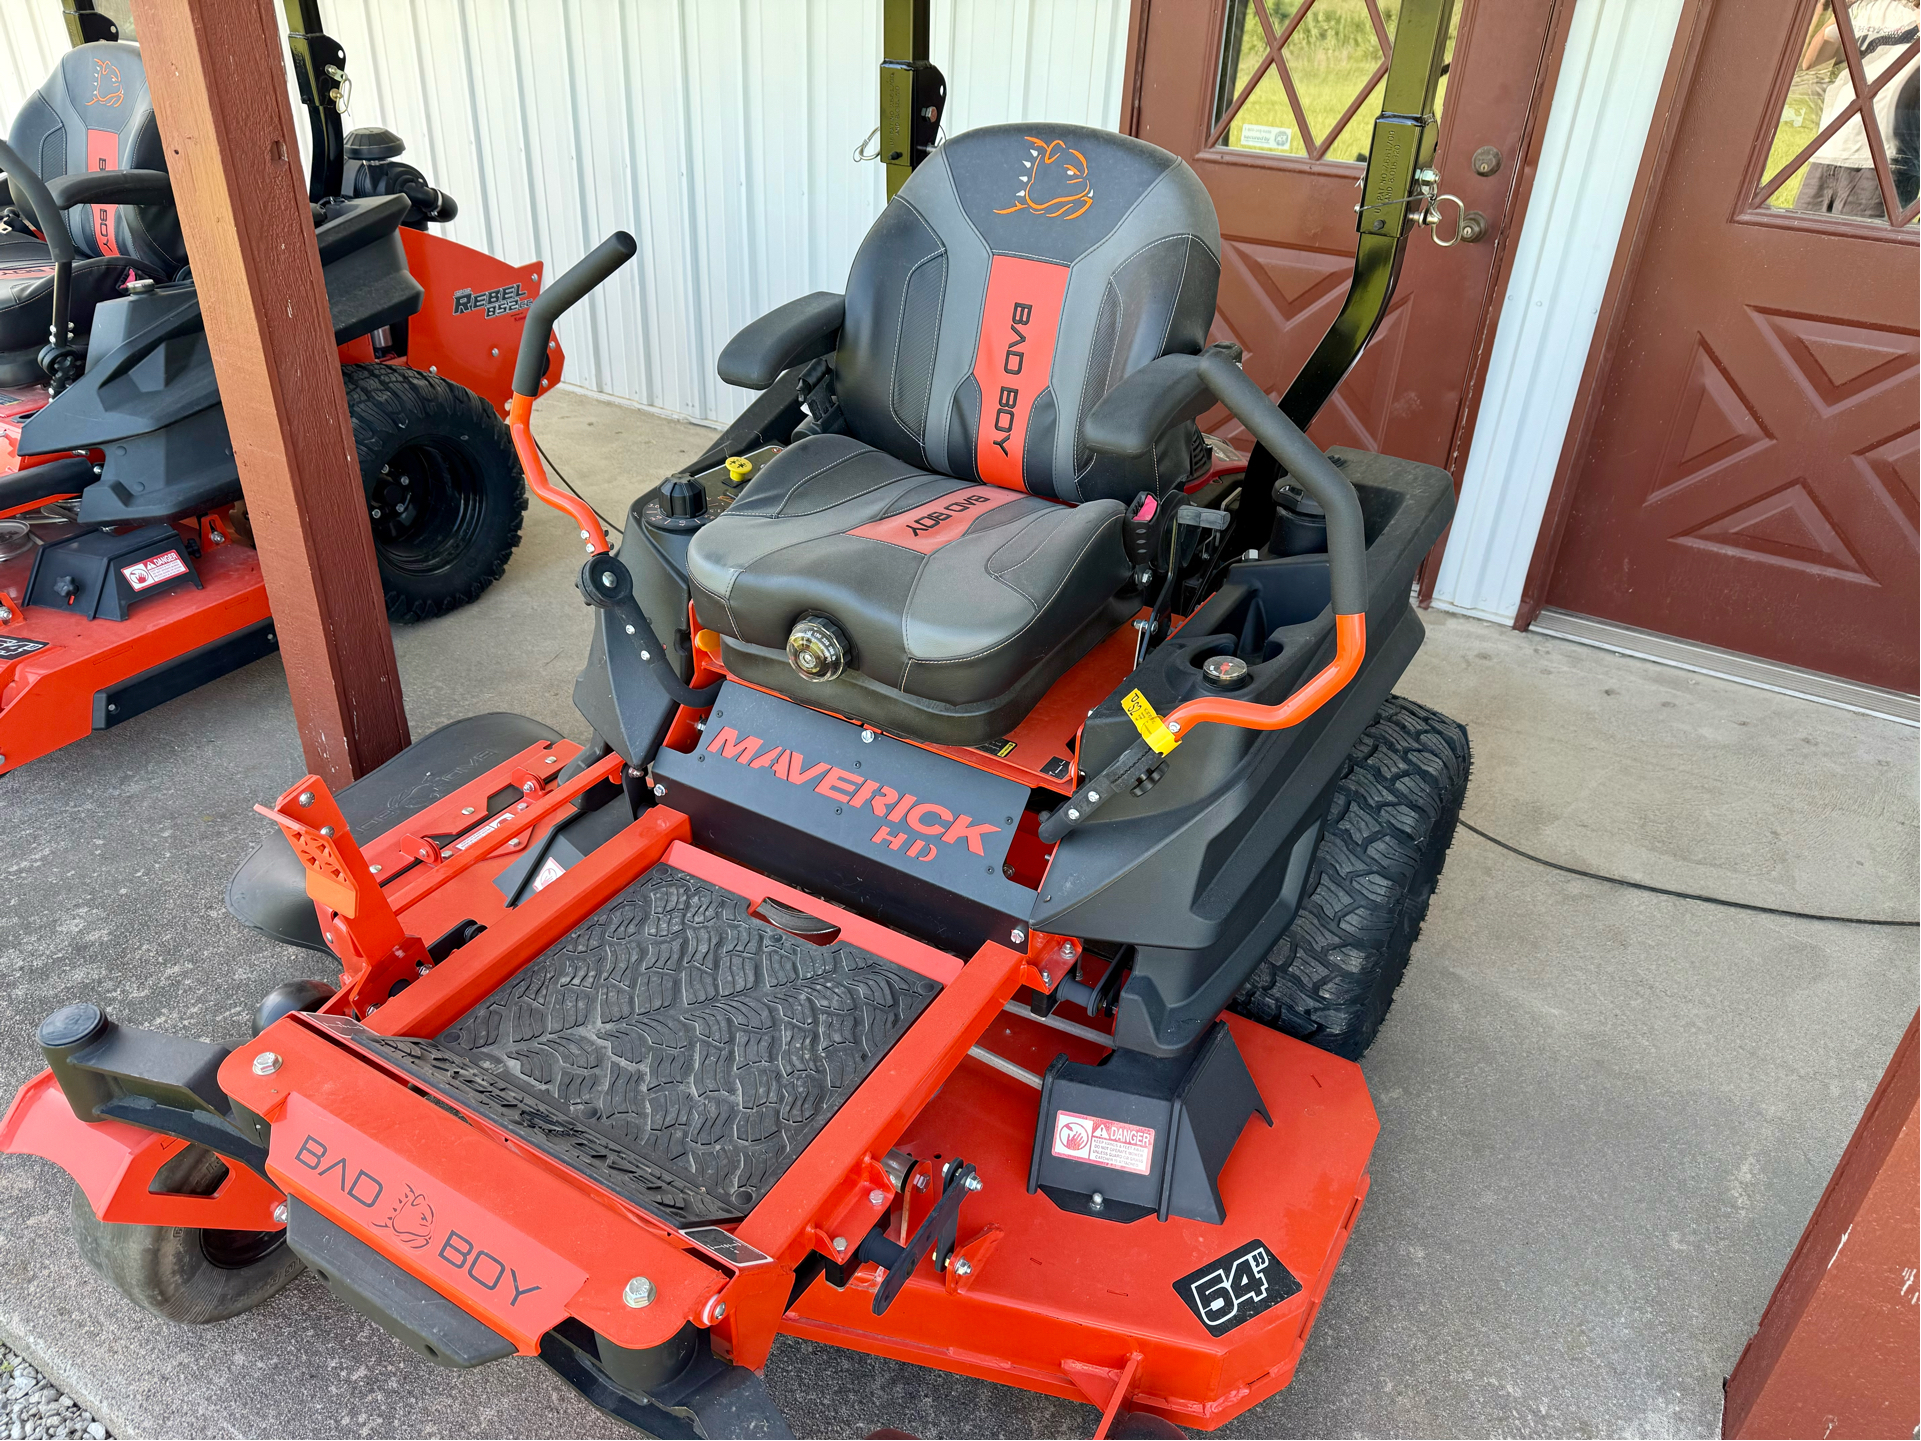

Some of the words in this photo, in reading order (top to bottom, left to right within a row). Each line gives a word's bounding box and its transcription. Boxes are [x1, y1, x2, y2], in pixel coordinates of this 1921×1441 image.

[1384, 186, 1393, 202] AND
[99, 208, 113, 253] BOY
[453, 283, 527, 316] REBEL
[1004, 302, 1033, 375] BAD
[993, 386, 1019, 458] BOY
[944, 494, 991, 513] BAD
[906, 511, 953, 537] BOY
[153, 552, 178, 567] DANGER
[706, 726, 1002, 857] MAVERICK
[870, 825, 938, 862] HD
[1110, 1126, 1150, 1147] DANGER
[294, 1134, 383, 1208] BAD
[438, 1229, 542, 1307] BOY
[1190, 1247, 1269, 1326] 54"
